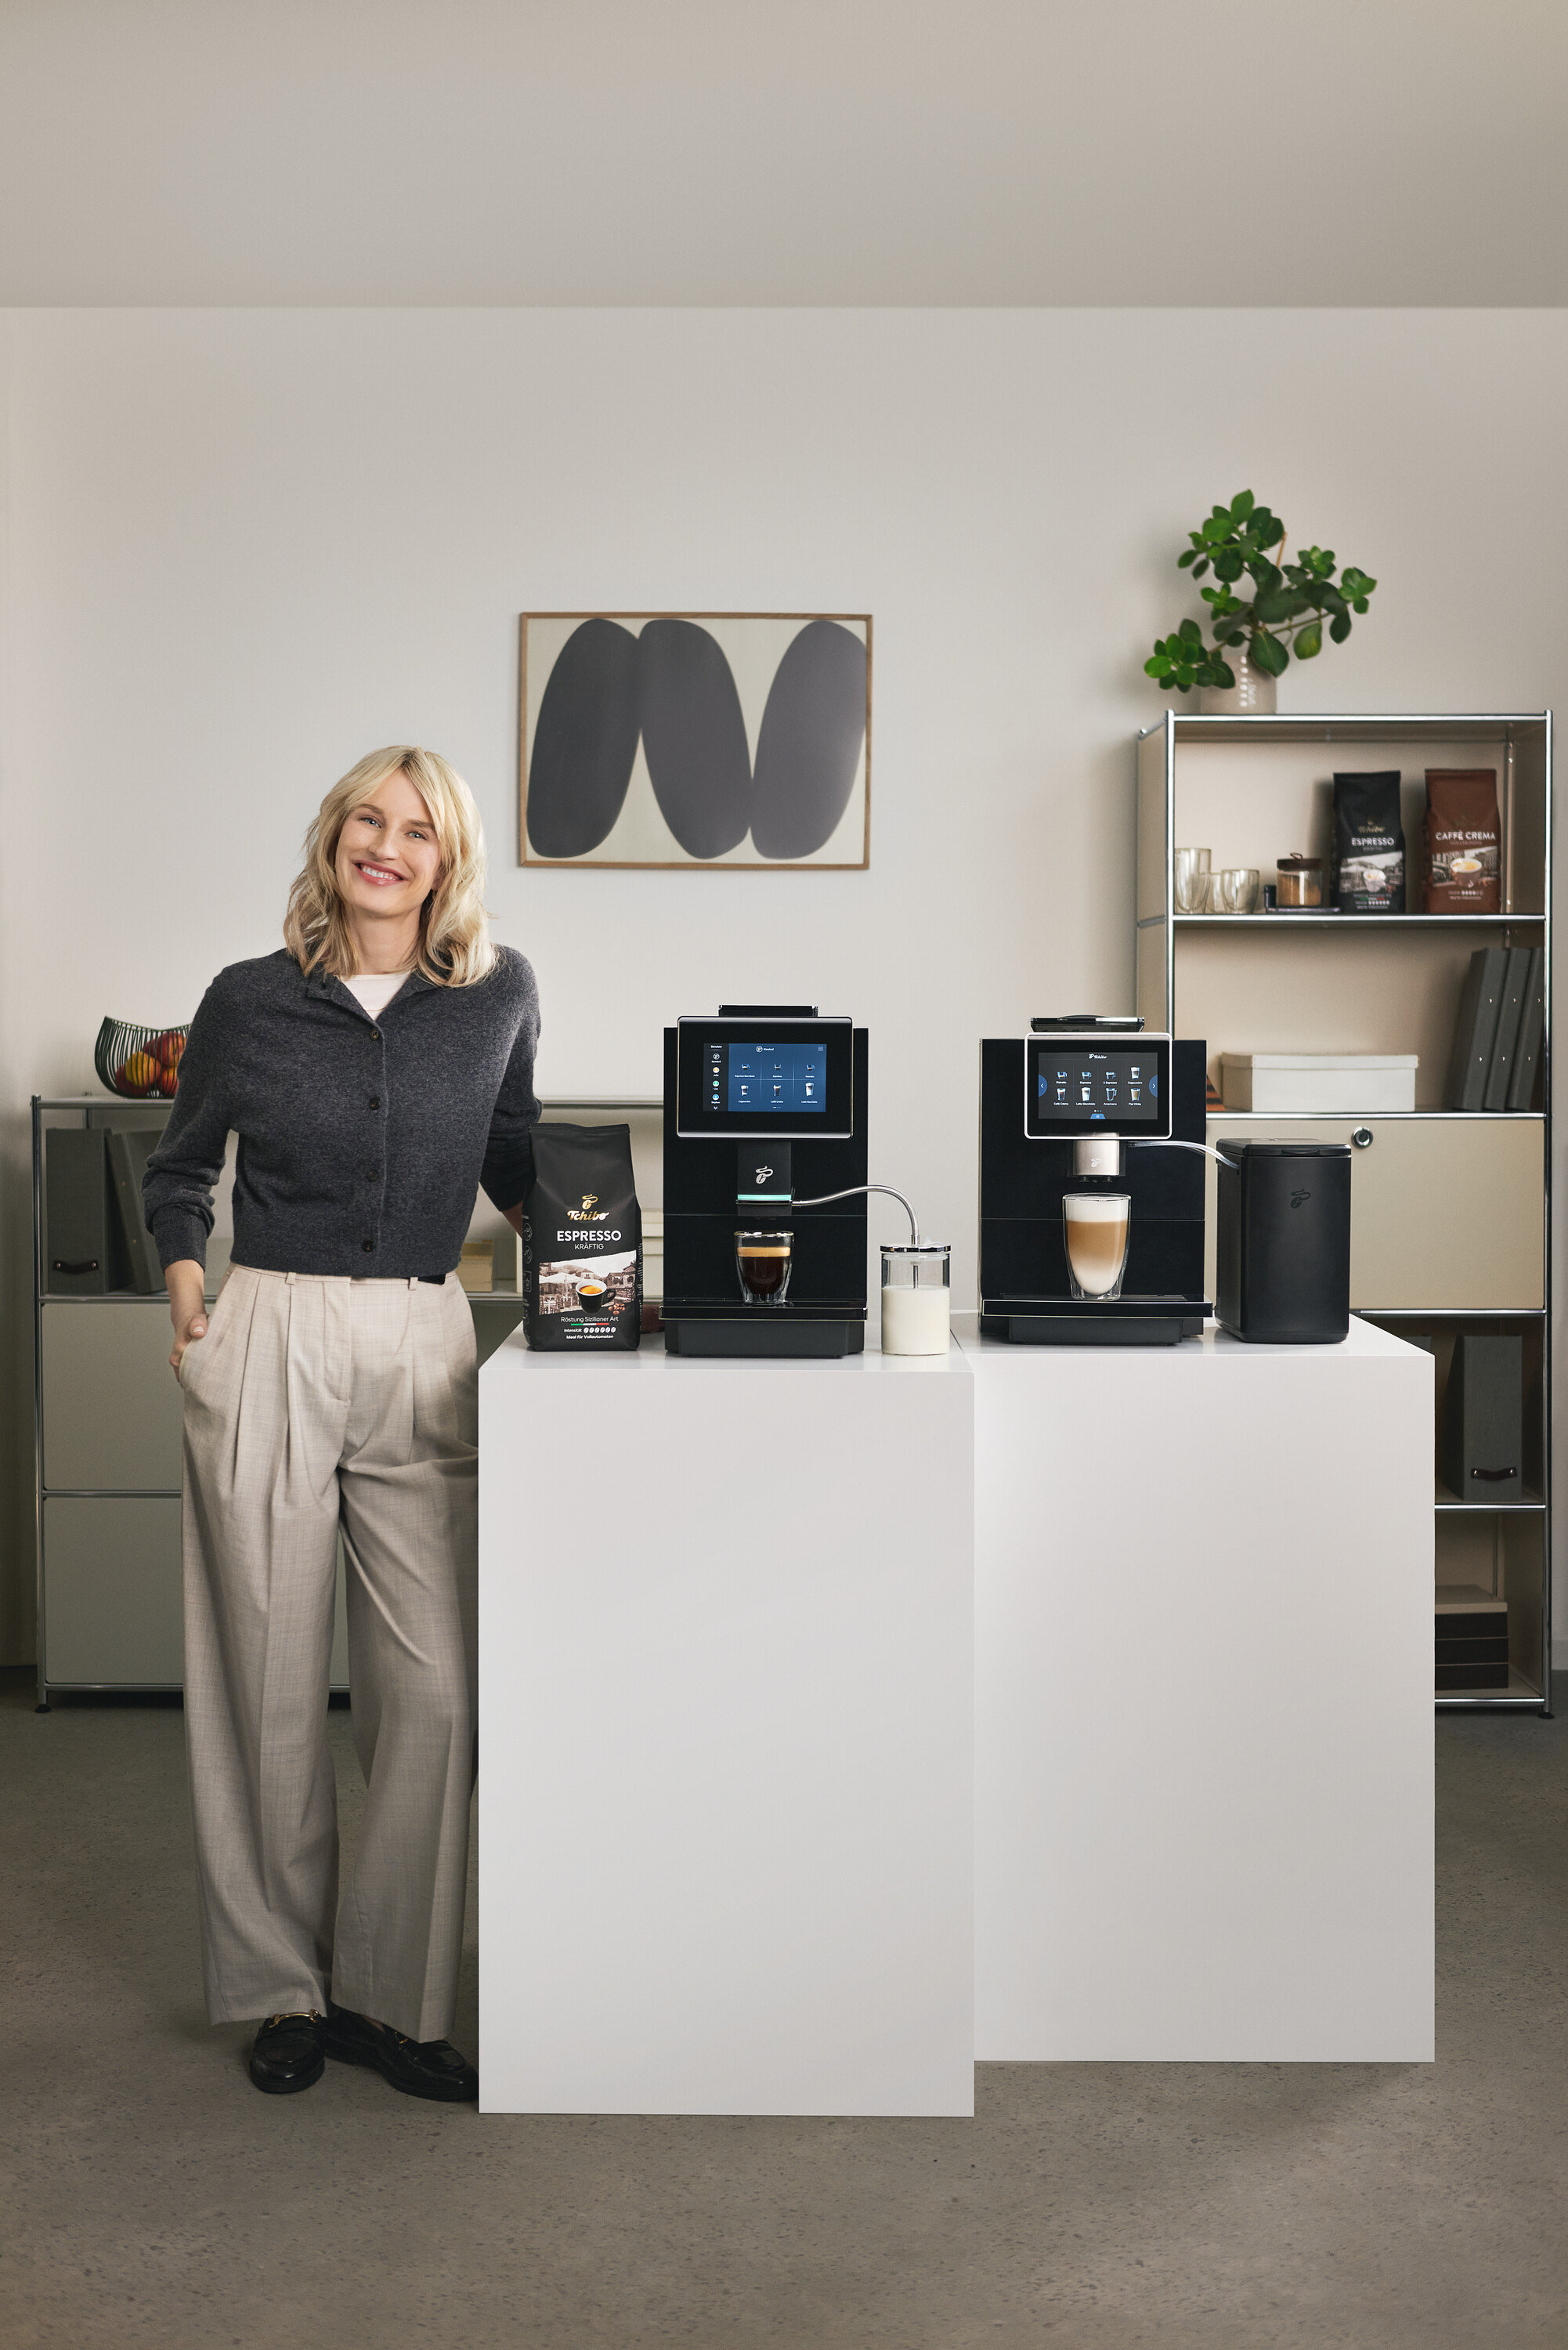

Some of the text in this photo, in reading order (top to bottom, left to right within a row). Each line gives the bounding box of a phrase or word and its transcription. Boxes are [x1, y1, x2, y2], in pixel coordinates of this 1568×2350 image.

[1436, 830, 1496, 841] CAFFÈ CREMA
[1351, 837, 1394, 846] ESPRESSO
[567, 1210, 610, 1221] Tchibo
[557, 1230, 622, 1242] ESPRESSO
